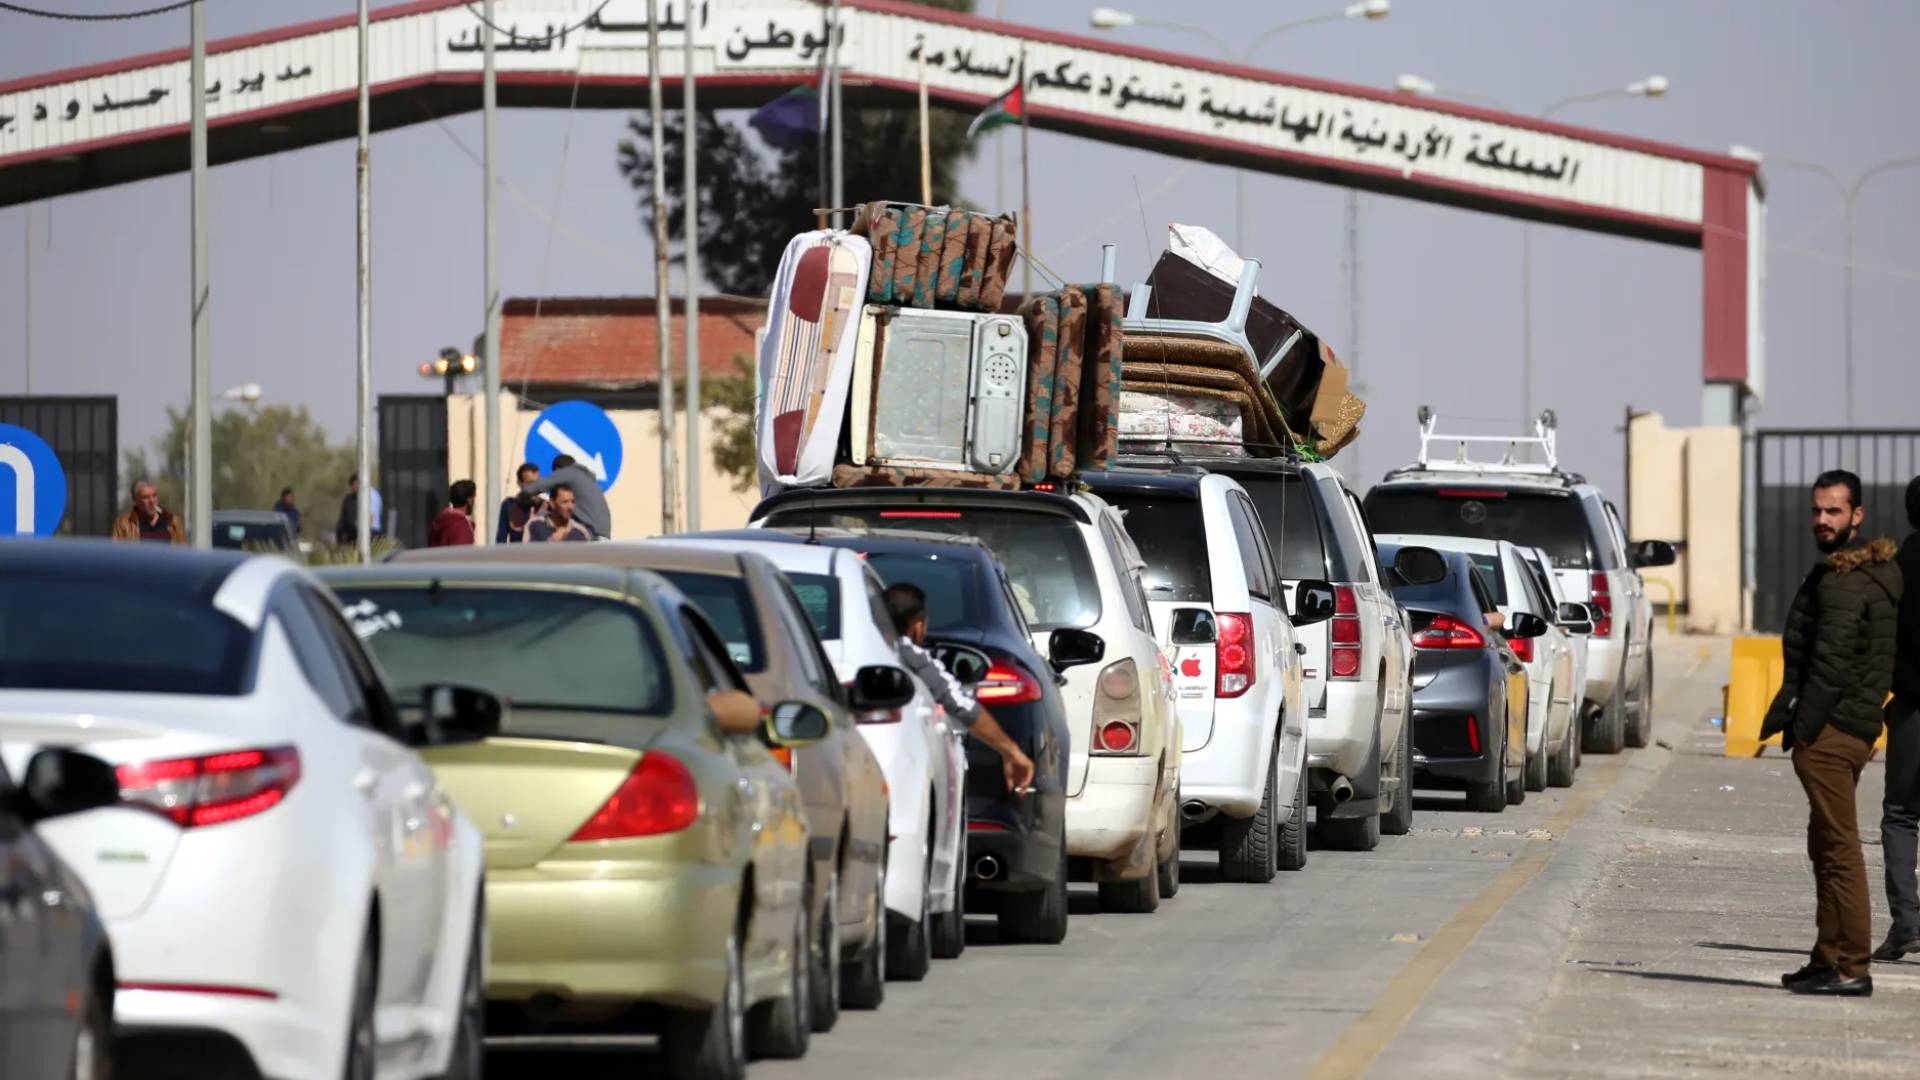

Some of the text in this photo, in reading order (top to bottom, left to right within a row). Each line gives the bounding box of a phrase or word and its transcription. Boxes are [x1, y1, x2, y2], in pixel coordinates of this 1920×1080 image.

[448, 23, 566, 52] الملك
[585, 2, 708, 31] اله
[727, 19, 845, 61] الوطن
[34, 66, 311, 121] مديري حدود
[907, 34, 1580, 184] المملكة الأردنية الهاشمية تستودعكم السلامة
